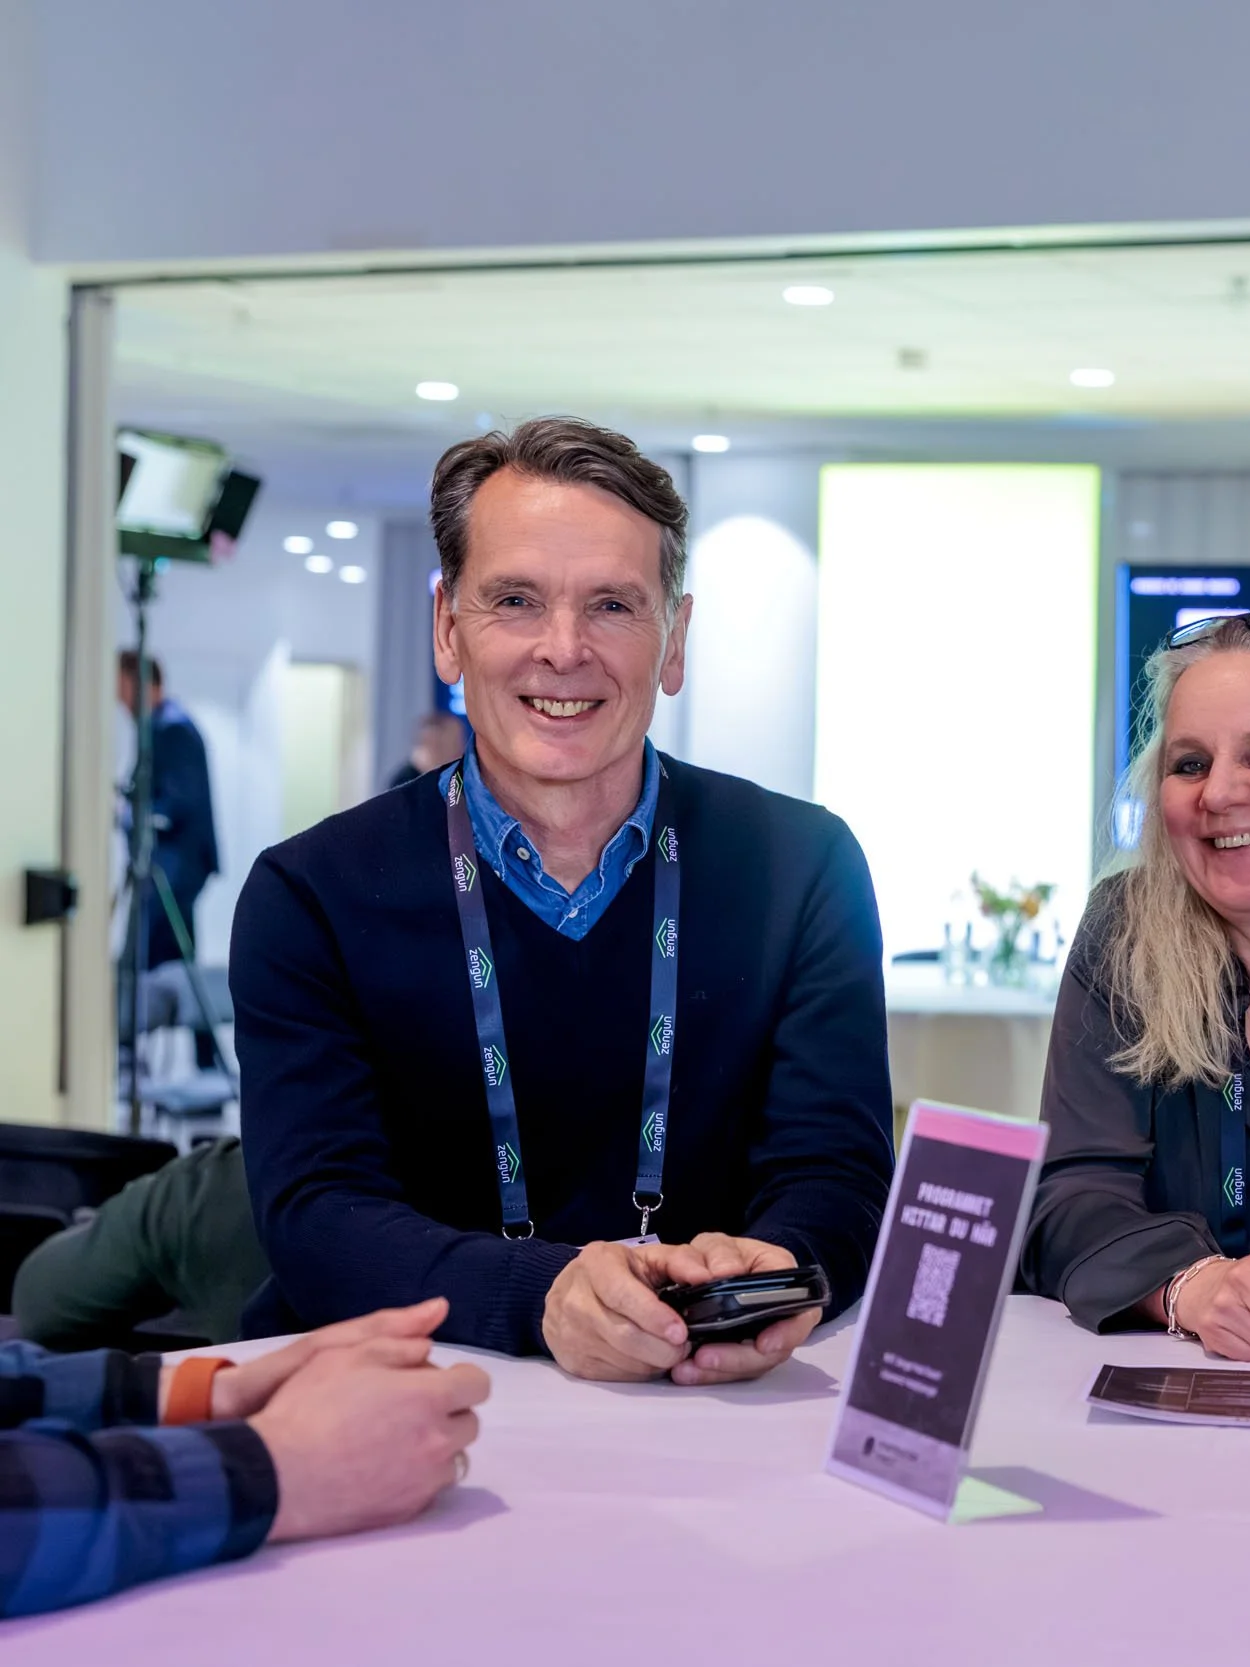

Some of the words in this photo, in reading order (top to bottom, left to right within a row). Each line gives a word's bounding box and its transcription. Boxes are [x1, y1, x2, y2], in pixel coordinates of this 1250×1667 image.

[667, 827, 679, 862] zengun
[454, 855, 467, 892] zengun
[666, 919, 678, 957] zengun
[469, 949, 483, 988] zengun
[661, 1015, 673, 1055] zengun
[483, 1047, 497, 1086] zengun
[1234, 1073, 1245, 1111] zengun
[653, 1112, 666, 1152] zengun
[497, 1144, 511, 1184] zengun
[1234, 1168, 1245, 1206] zengun
